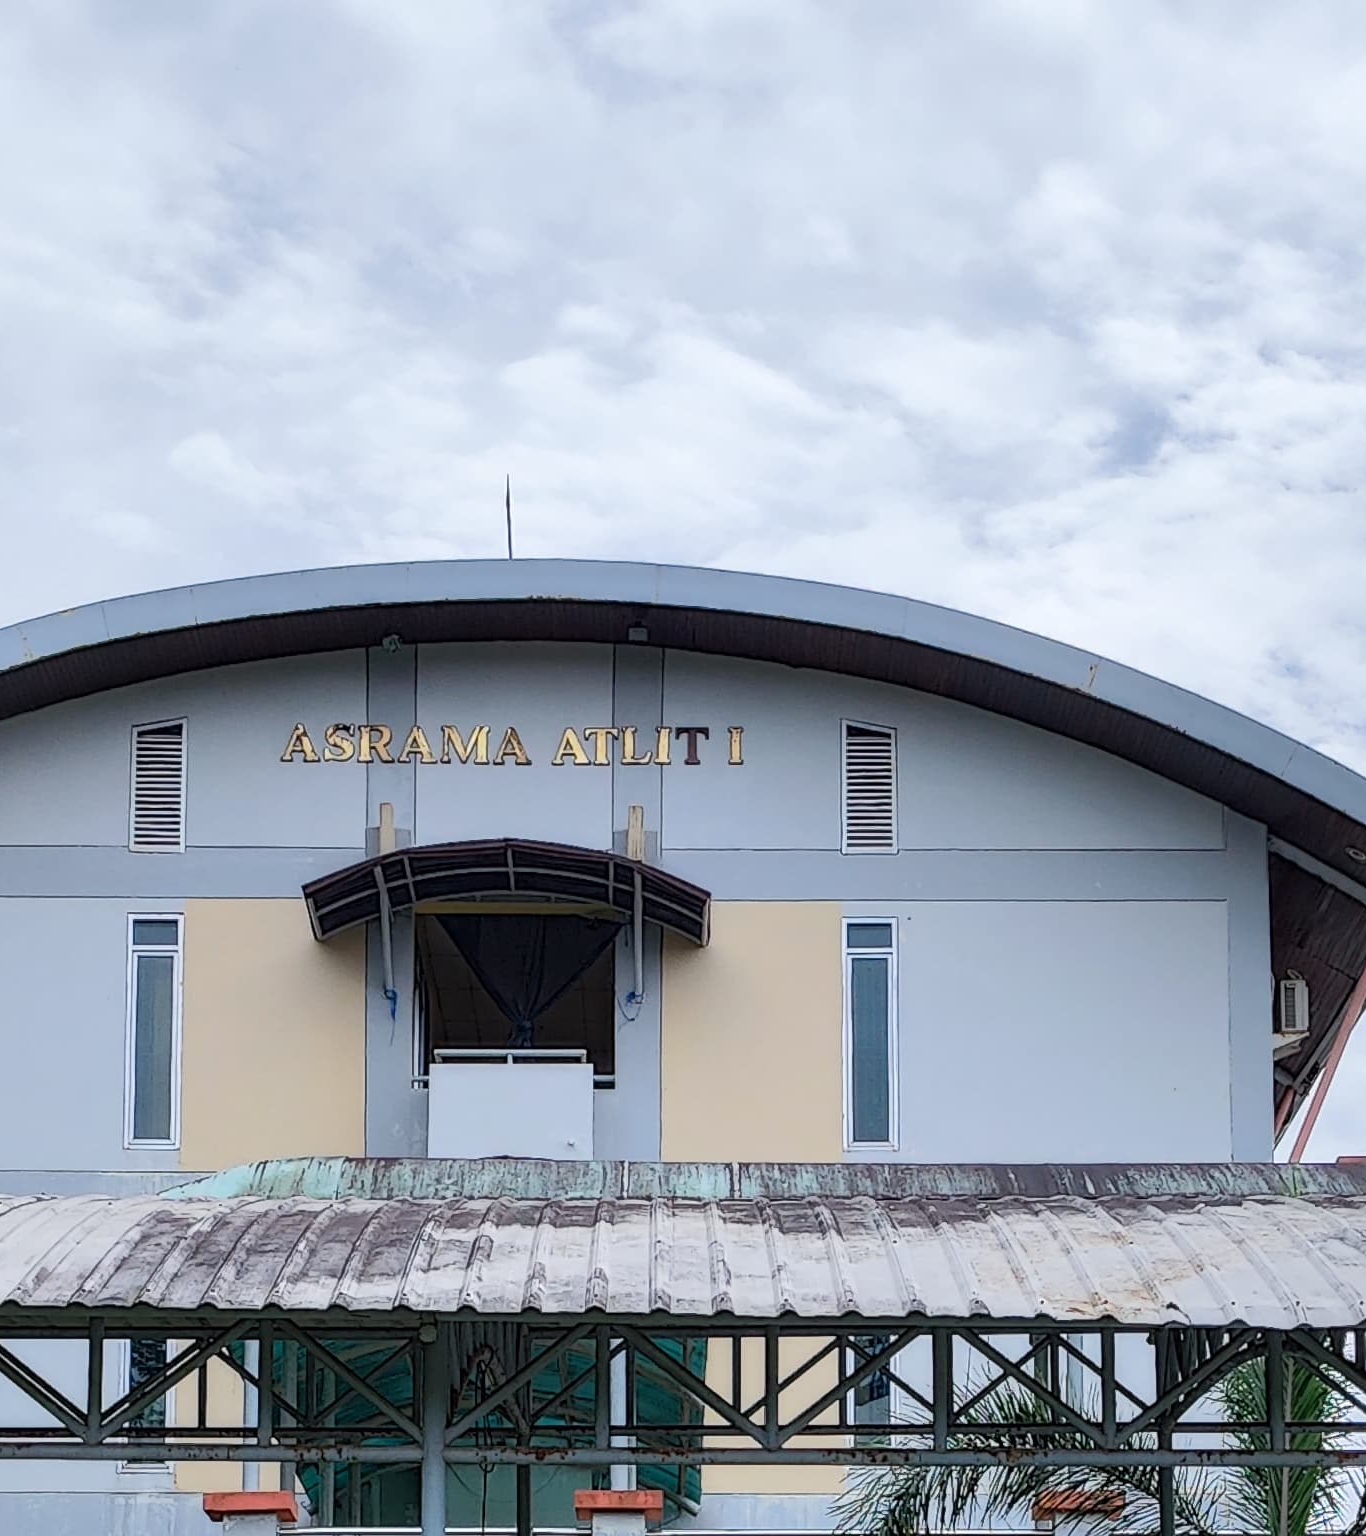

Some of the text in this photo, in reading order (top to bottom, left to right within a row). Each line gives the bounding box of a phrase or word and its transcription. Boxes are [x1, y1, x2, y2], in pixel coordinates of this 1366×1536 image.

[280, 723, 745, 766] ASRAMA ATLIT I
